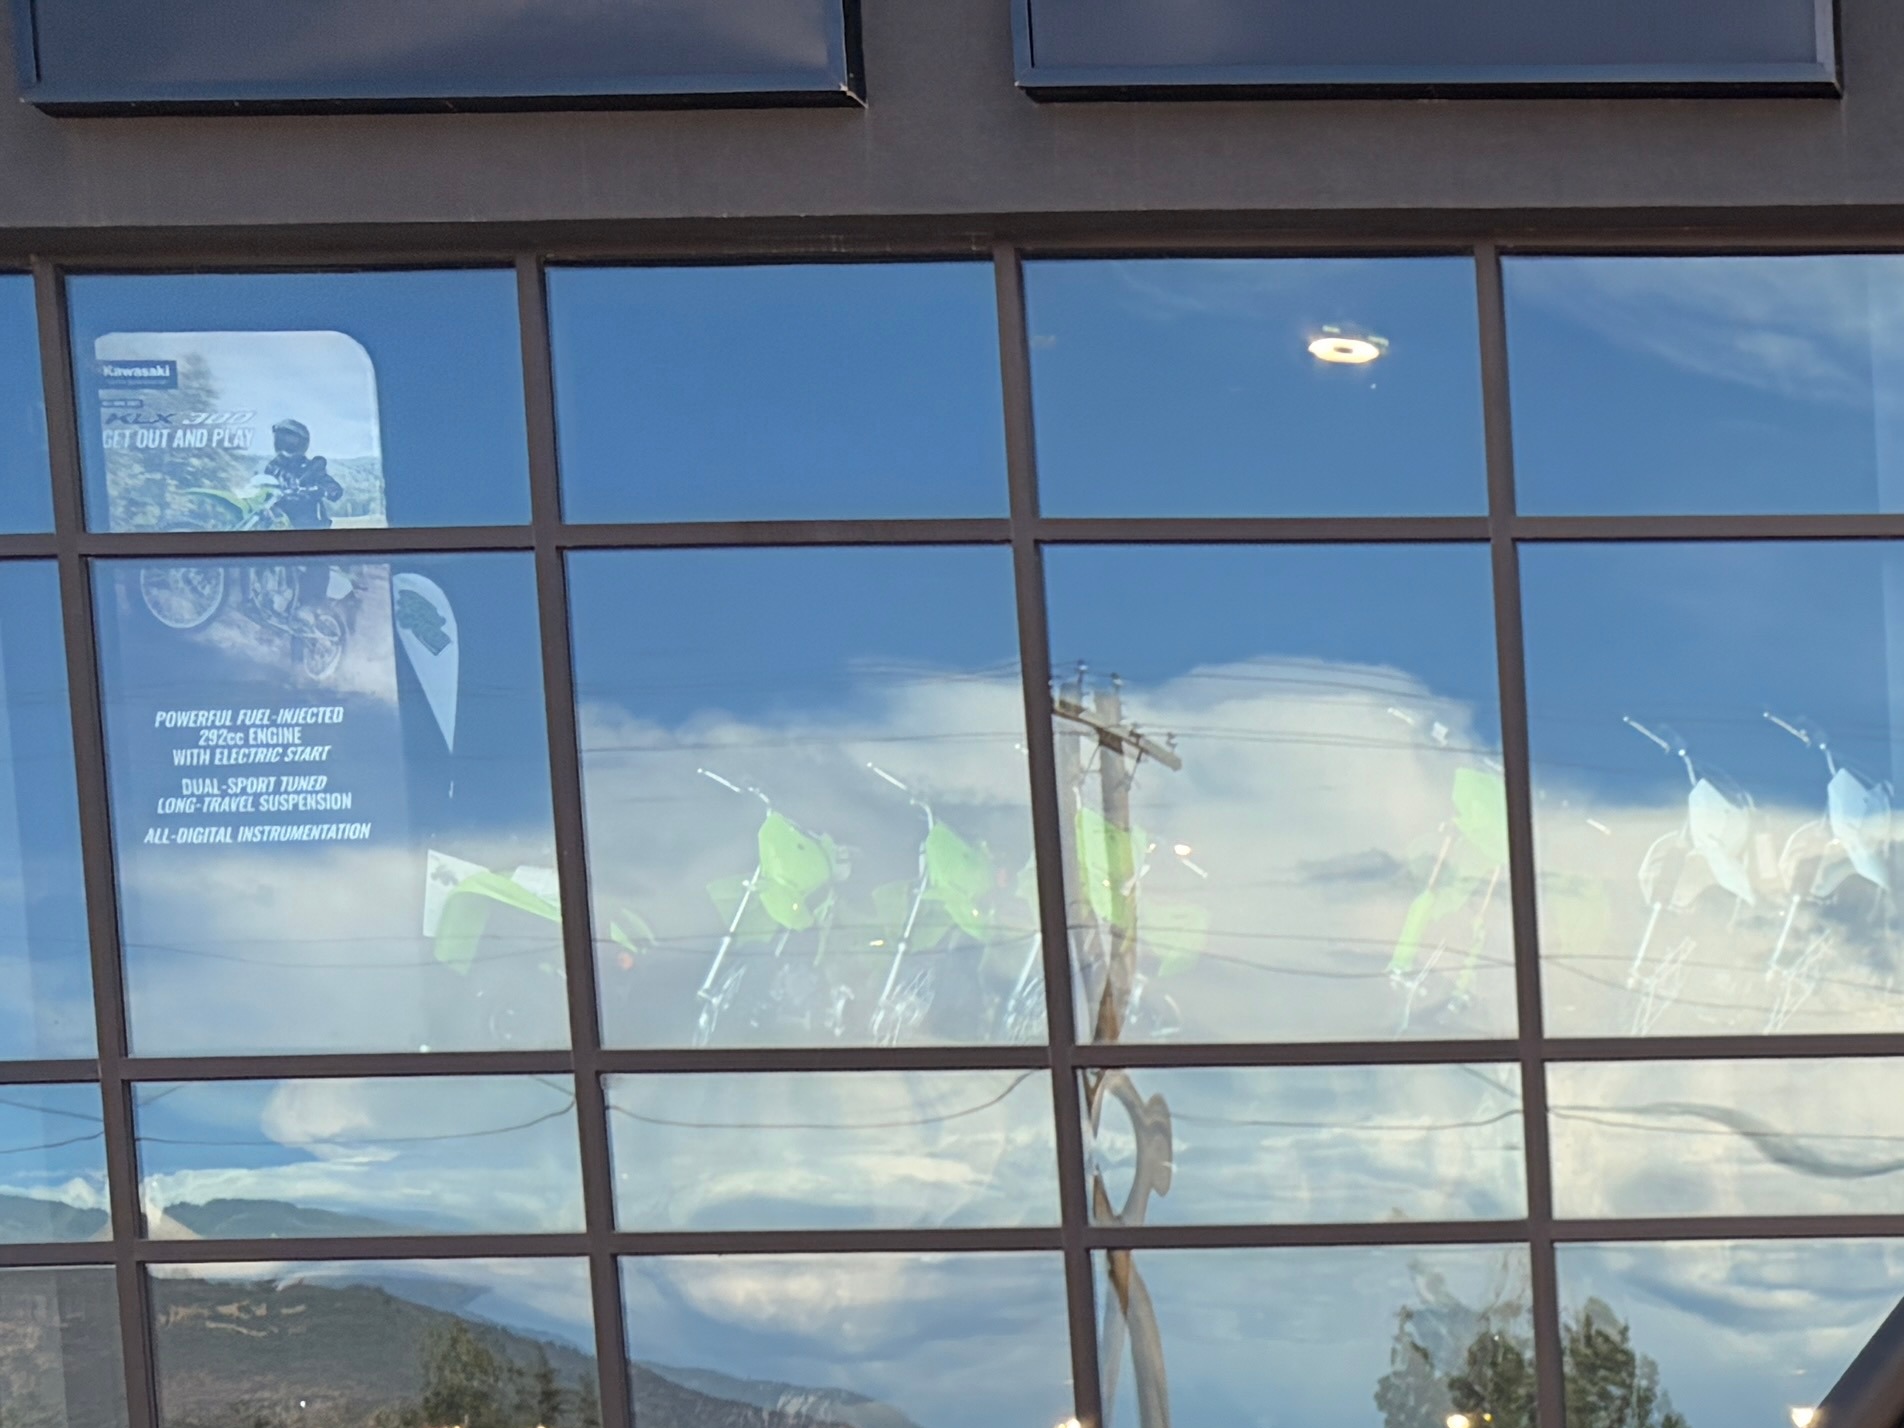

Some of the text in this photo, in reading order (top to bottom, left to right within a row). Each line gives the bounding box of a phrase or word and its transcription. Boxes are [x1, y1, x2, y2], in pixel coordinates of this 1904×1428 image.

[103, 364, 171, 378] Kawasaki
[105, 411, 258, 425] KLX 300
[102, 427, 255, 449] GET OUT AND PLAY
[155, 706, 345, 728] POWERFUL FUEL-INJECTED
[198, 726, 303, 746] 292cc ENGINE
[172, 744, 332, 766] WITH ELECTRIC START
[181, 775, 328, 796] DUAL-SPORT TUNED
[157, 791, 352, 815] LONG-TRAVEL SUSPENSION
[143, 822, 372, 845] ALL-DIGITAL INSTRUMENTATION
